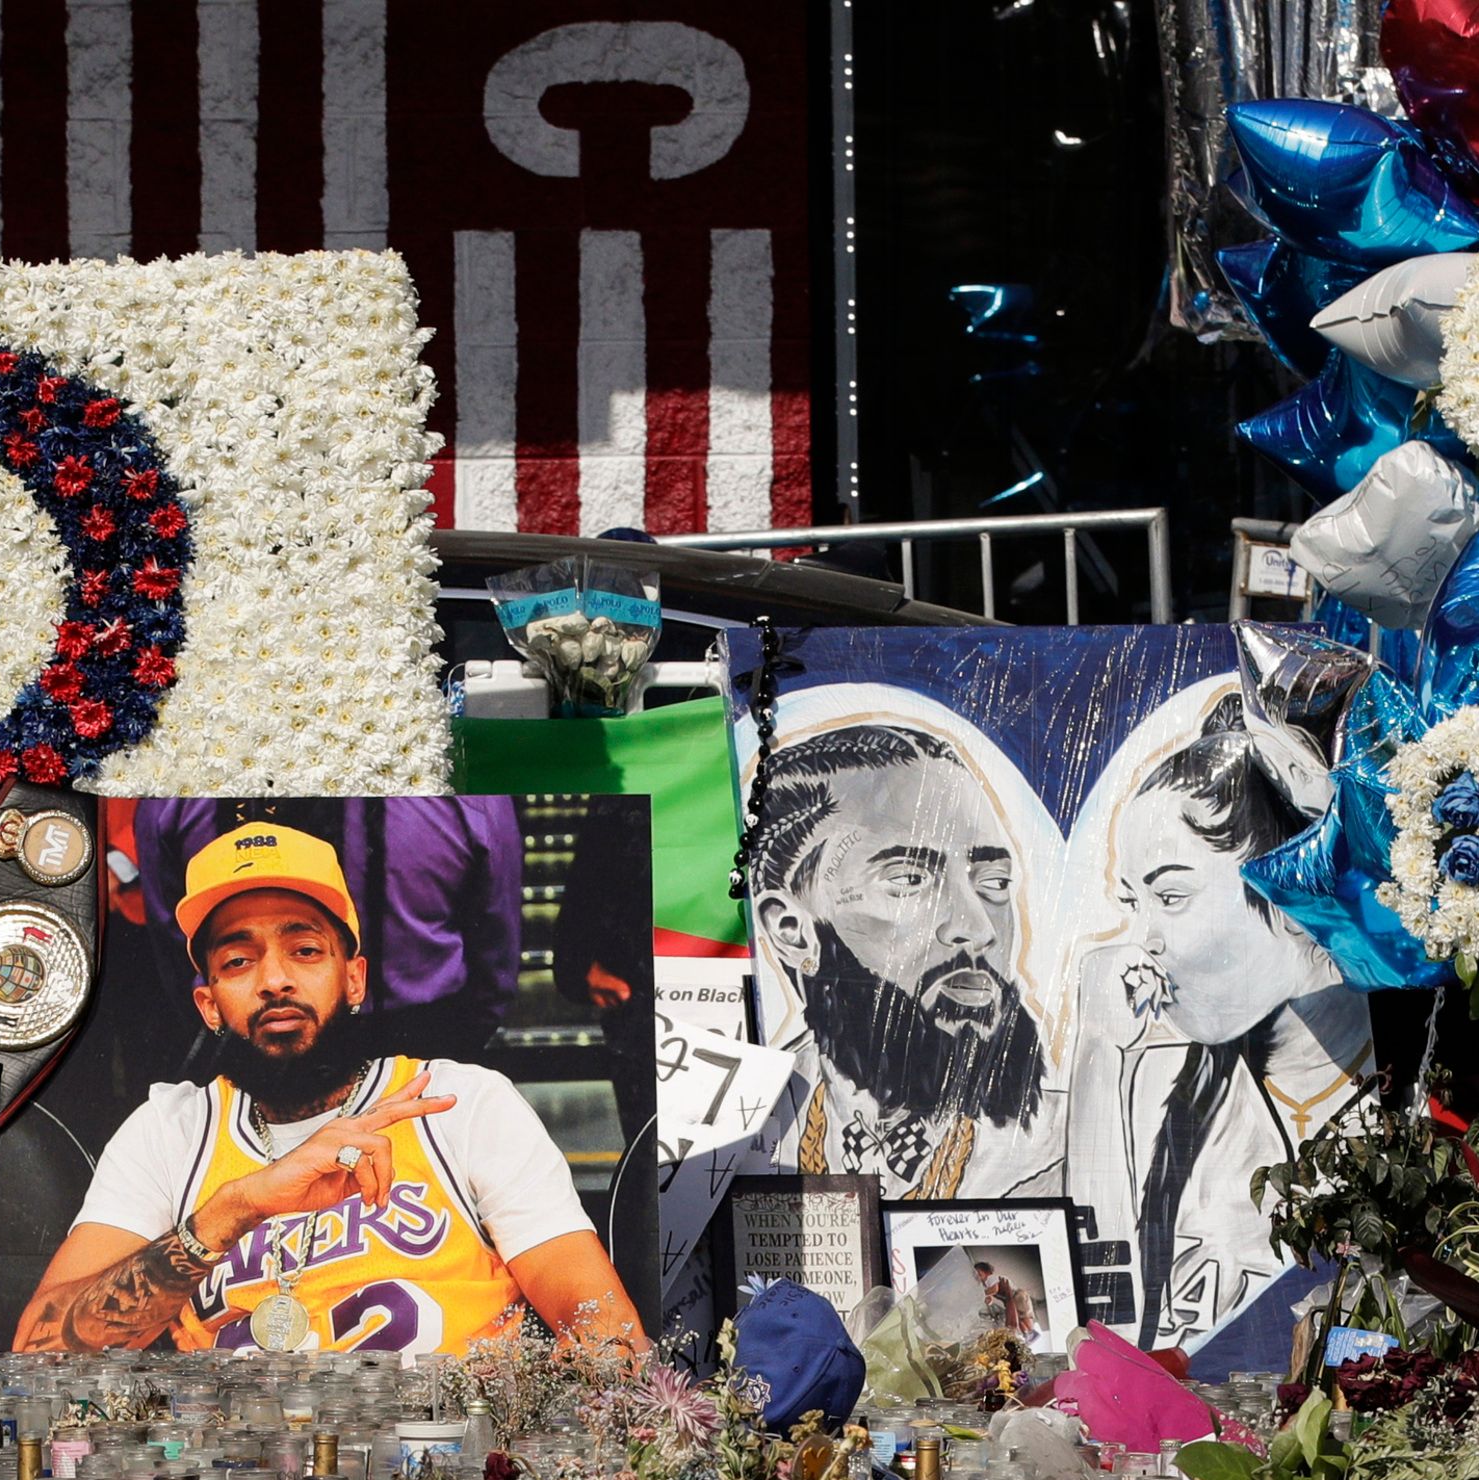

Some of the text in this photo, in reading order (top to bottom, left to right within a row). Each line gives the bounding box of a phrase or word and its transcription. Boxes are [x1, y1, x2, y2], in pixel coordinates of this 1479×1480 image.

[234, 835, 278, 850] 1988
[669, 990, 693, 1001] on
[744, 1213, 851, 1228] WHEN YOU'RE
[927, 1211, 970, 1227] Forever
[748, 1232, 848, 1248] TEMPTED TO
[746, 1252, 853, 1266] LOSE PATIENCE
